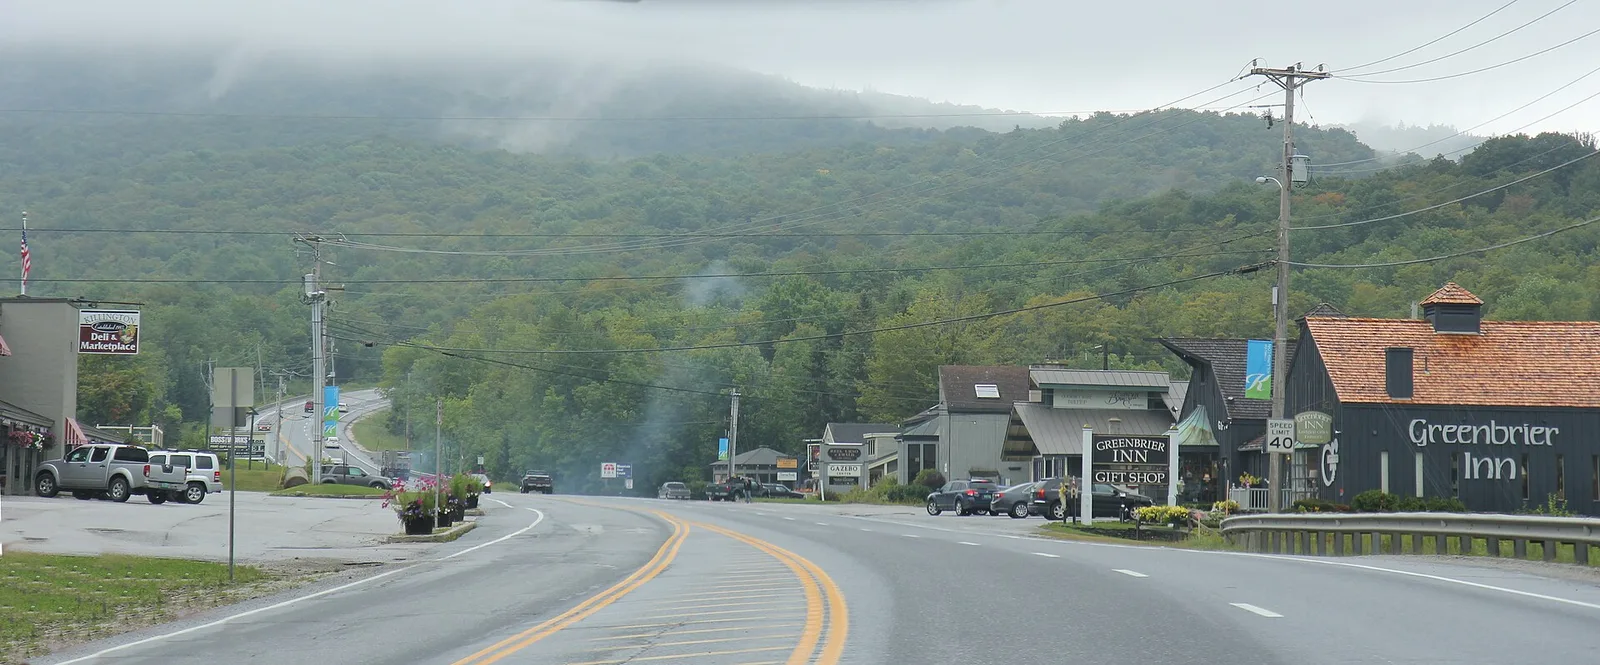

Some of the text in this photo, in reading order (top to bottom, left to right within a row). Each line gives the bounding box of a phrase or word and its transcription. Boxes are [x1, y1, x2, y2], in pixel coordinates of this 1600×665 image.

[84, 313, 136, 323] KILLINGTON
[81, 342, 136, 351] Marketplace
[1304, 420, 1324, 429] INN
[1409, 419, 1559, 446] Greenbrier
[1096, 438, 1166, 452] GREENBRIER
[1269, 436, 1293, 449] 40
[1112, 449, 1149, 463] INN
[1464, 452, 1516, 479] Inn
[1095, 471, 1165, 484] GIFT SHOP
